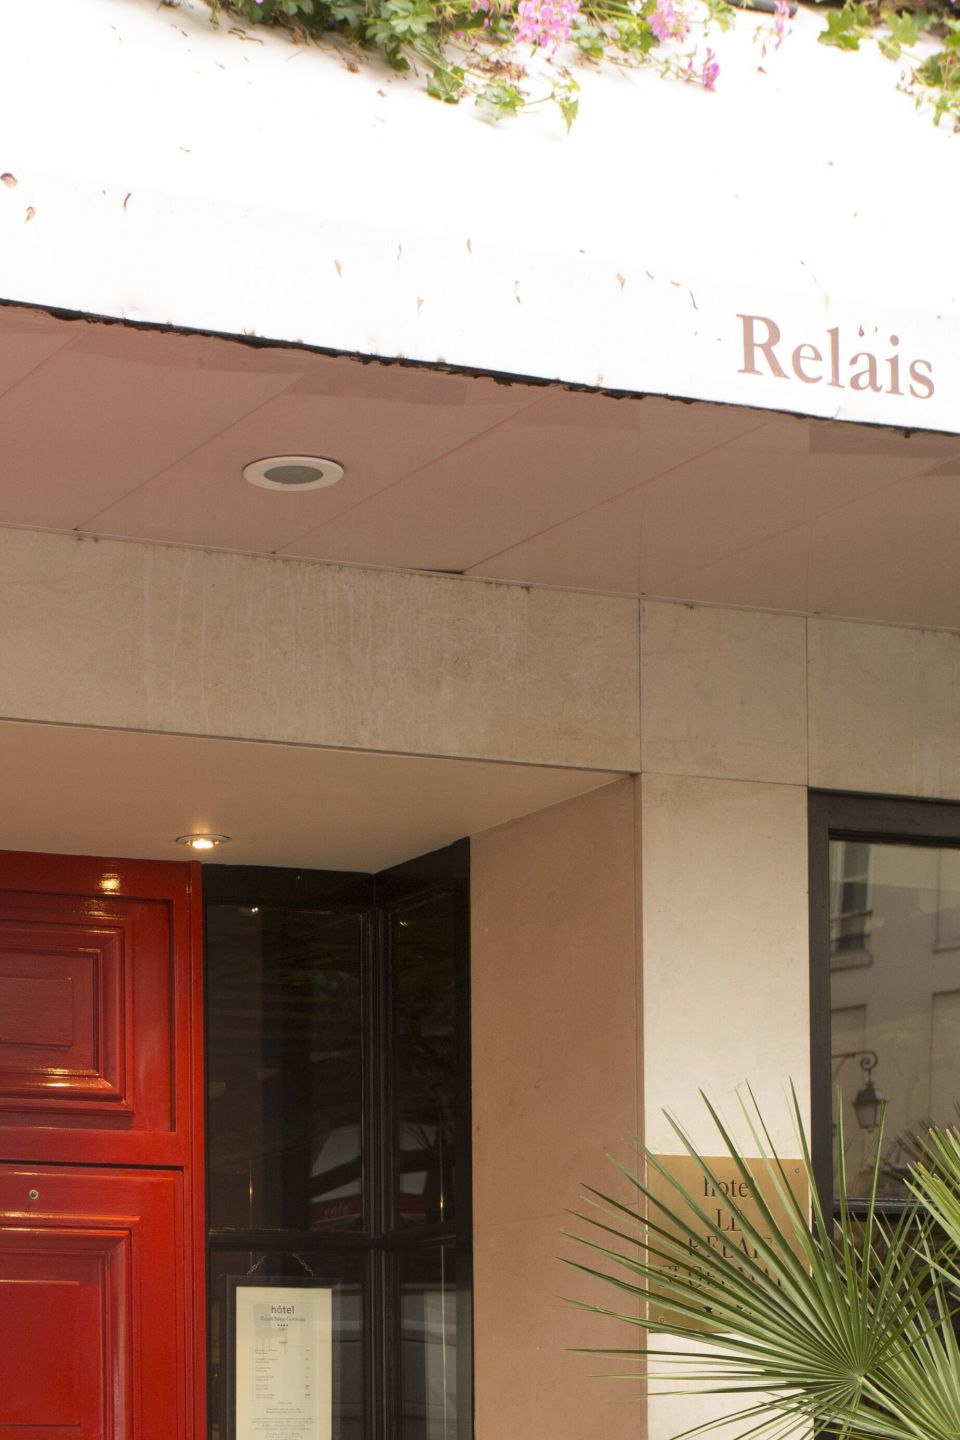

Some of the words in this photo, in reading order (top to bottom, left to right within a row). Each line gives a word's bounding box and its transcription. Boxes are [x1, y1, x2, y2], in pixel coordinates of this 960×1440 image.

[736, 313, 935, 399] Relais
[703, 1175, 755, 1199] hote
[271, 1305, 295, 1314] hôtel
